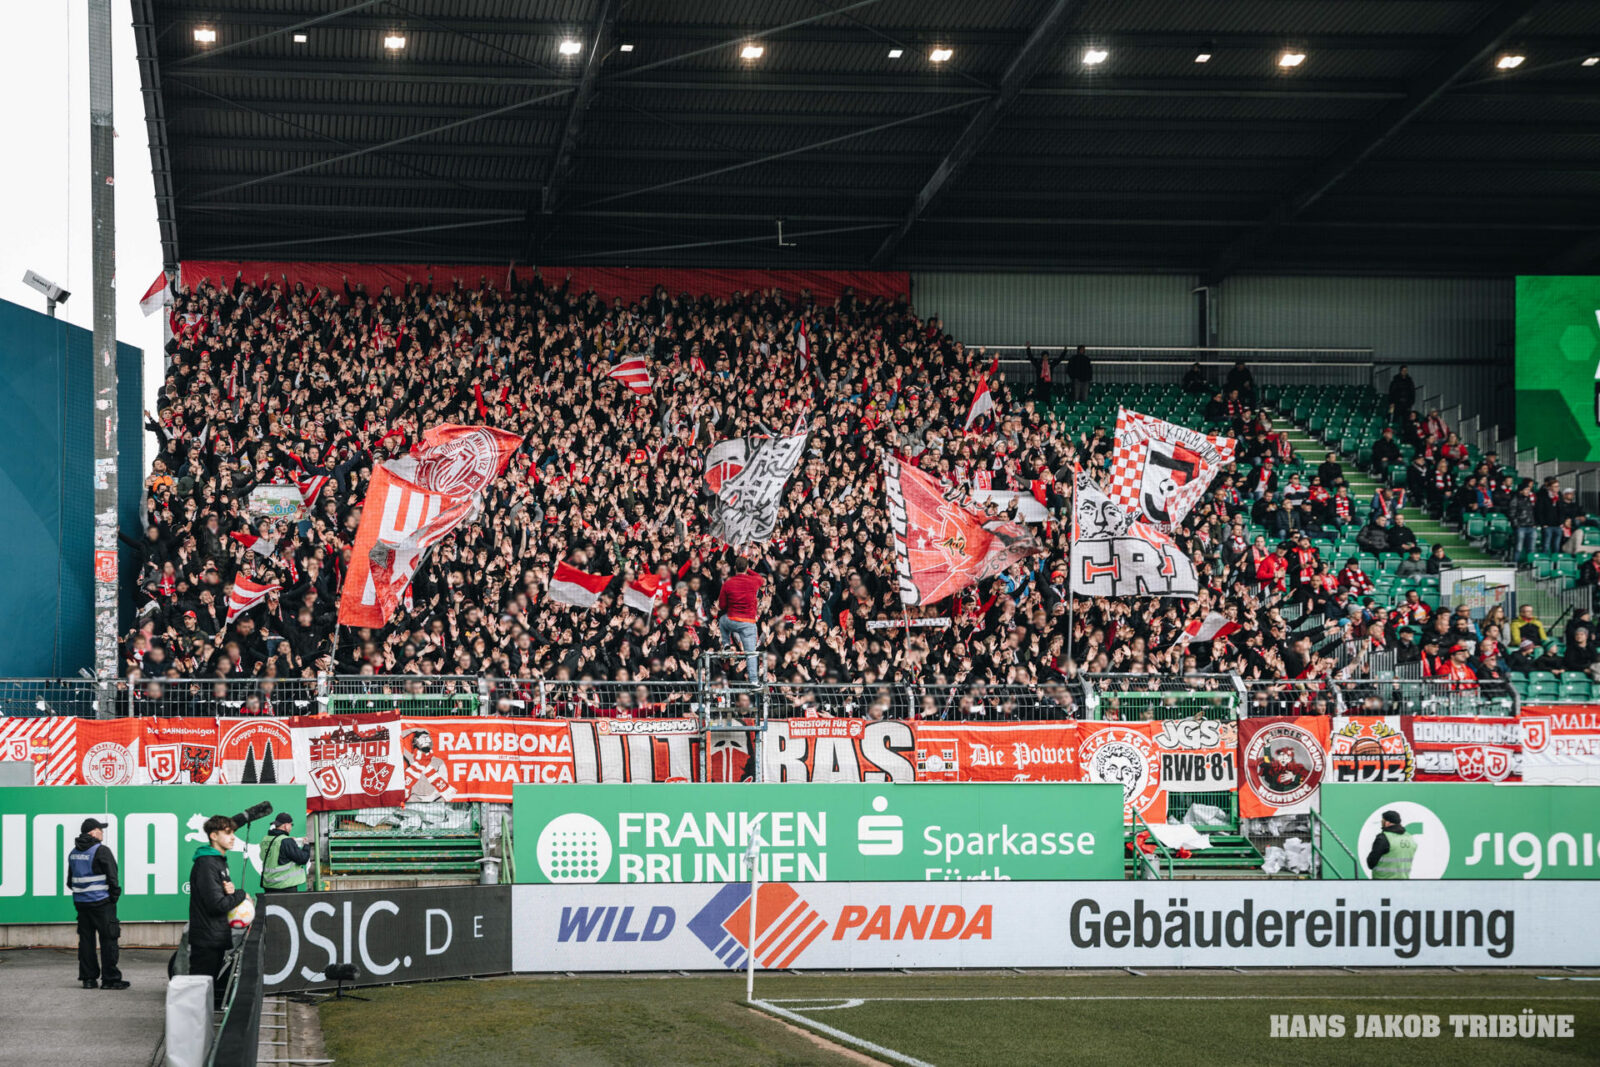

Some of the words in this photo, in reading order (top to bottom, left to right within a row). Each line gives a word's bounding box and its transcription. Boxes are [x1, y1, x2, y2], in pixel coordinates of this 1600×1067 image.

[790, 720, 831, 728] CHRISTOPH
[832, 719, 848, 728] FÜR
[791, 728, 816, 736] IMMER
[817, 728, 830, 736] BEI
[832, 728, 848, 736] UNS
[1155, 719, 1220, 749] JGS
[1551, 714, 1600, 730] MALL
[438, 732, 572, 753] RATISBONA
[968, 743, 1005, 767] Die
[1012, 742, 1075, 770] Power
[452, 762, 574, 783] FANATICA
[618, 811, 827, 848] FRANKEN
[922, 824, 1096, 863] Sparkasse
[557, 905, 677, 943] WILD
[831, 904, 993, 941] PANDA
[1069, 897, 1516, 959] Gebäudereinigung
